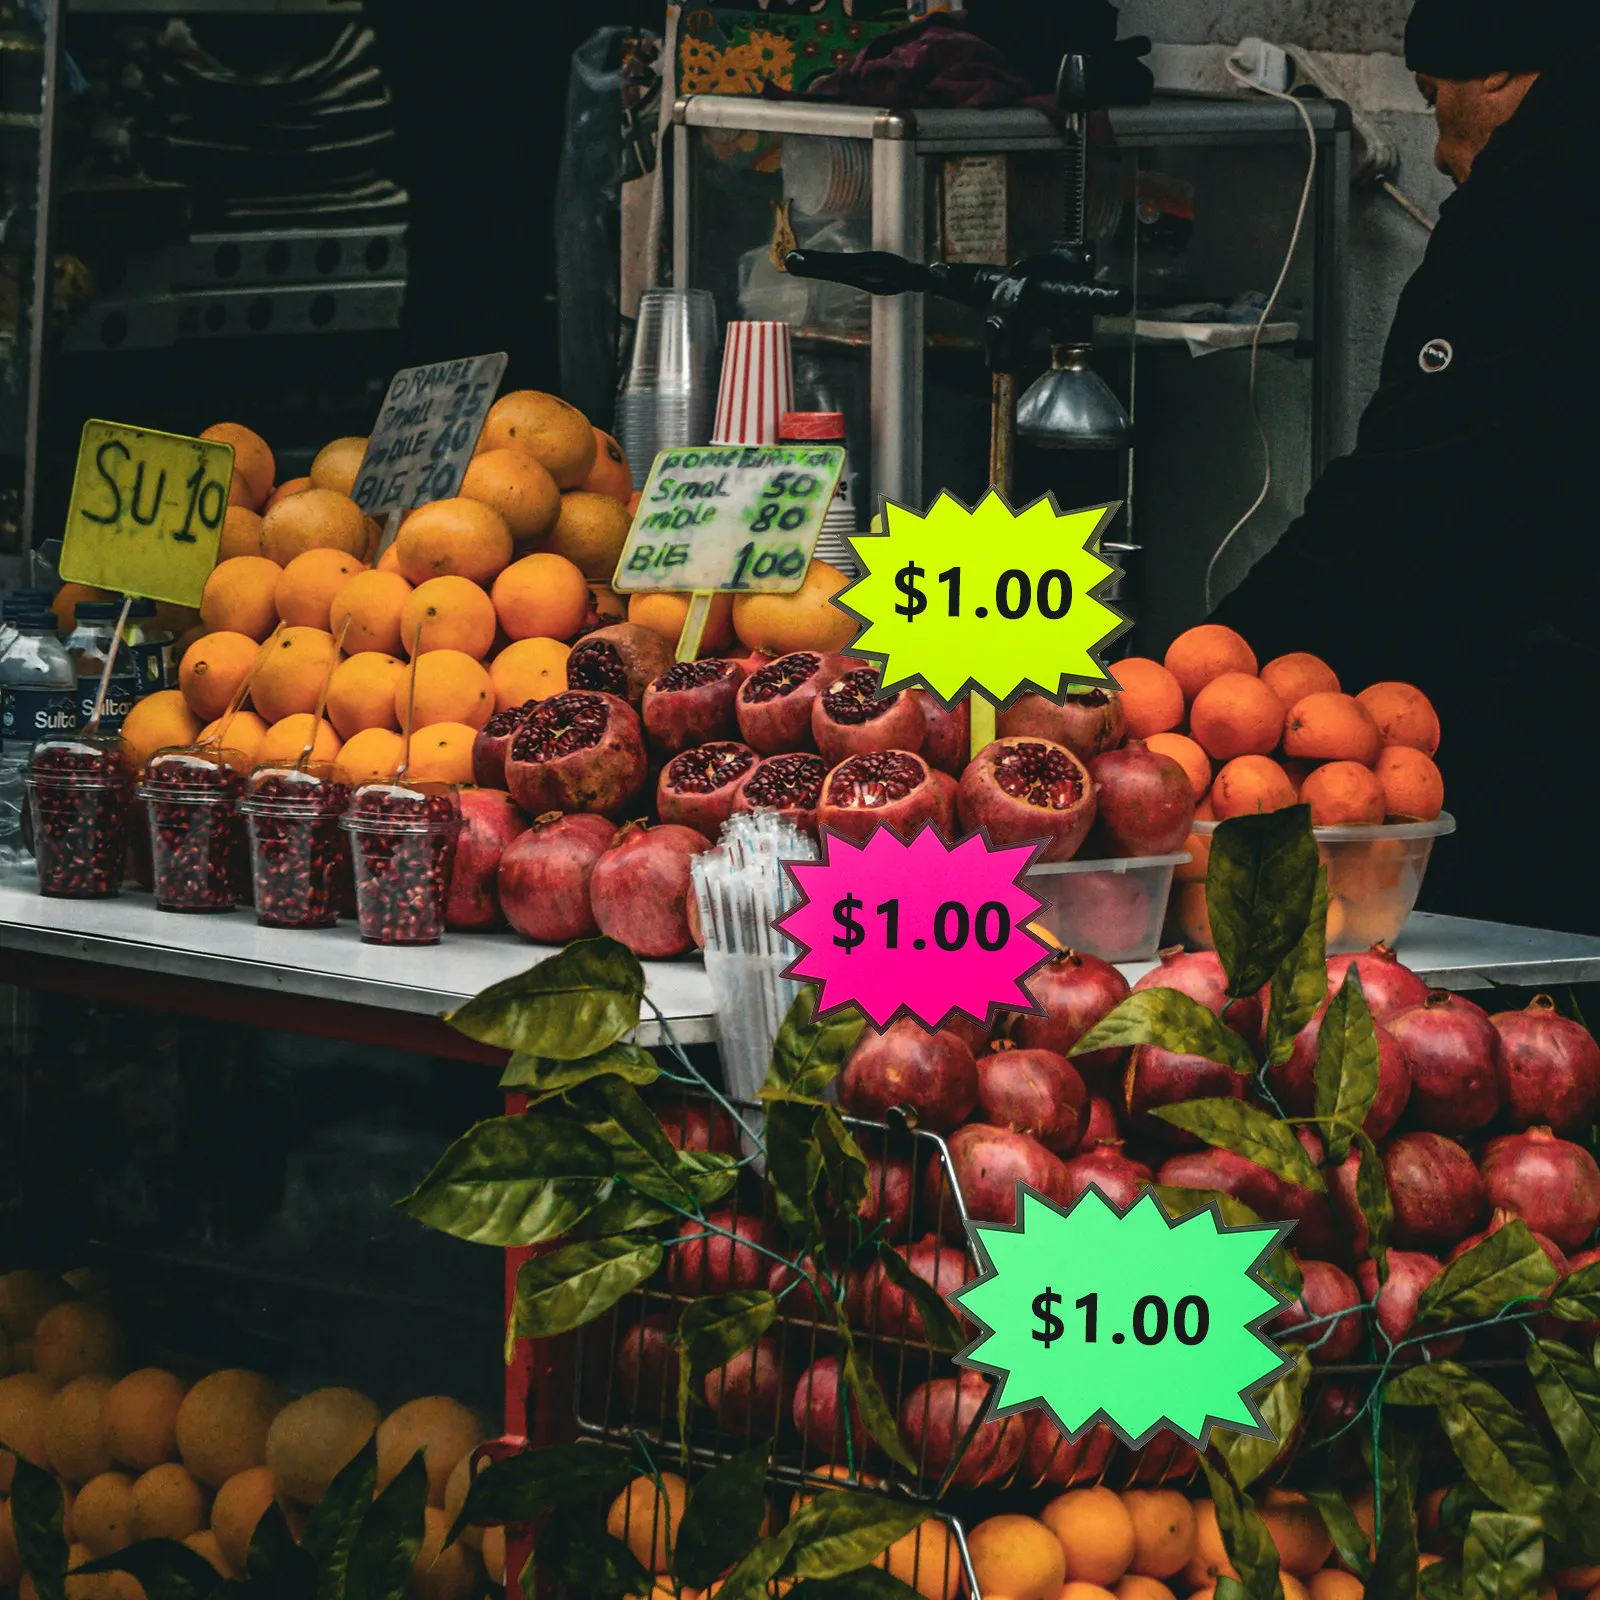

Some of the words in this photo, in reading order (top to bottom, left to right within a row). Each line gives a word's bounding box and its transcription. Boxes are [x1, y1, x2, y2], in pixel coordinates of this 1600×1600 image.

[762, 472, 817, 499] 50
[749, 503, 807, 532] 80
[627, 543, 690, 571] BIG
[720, 541, 805, 589] 100
